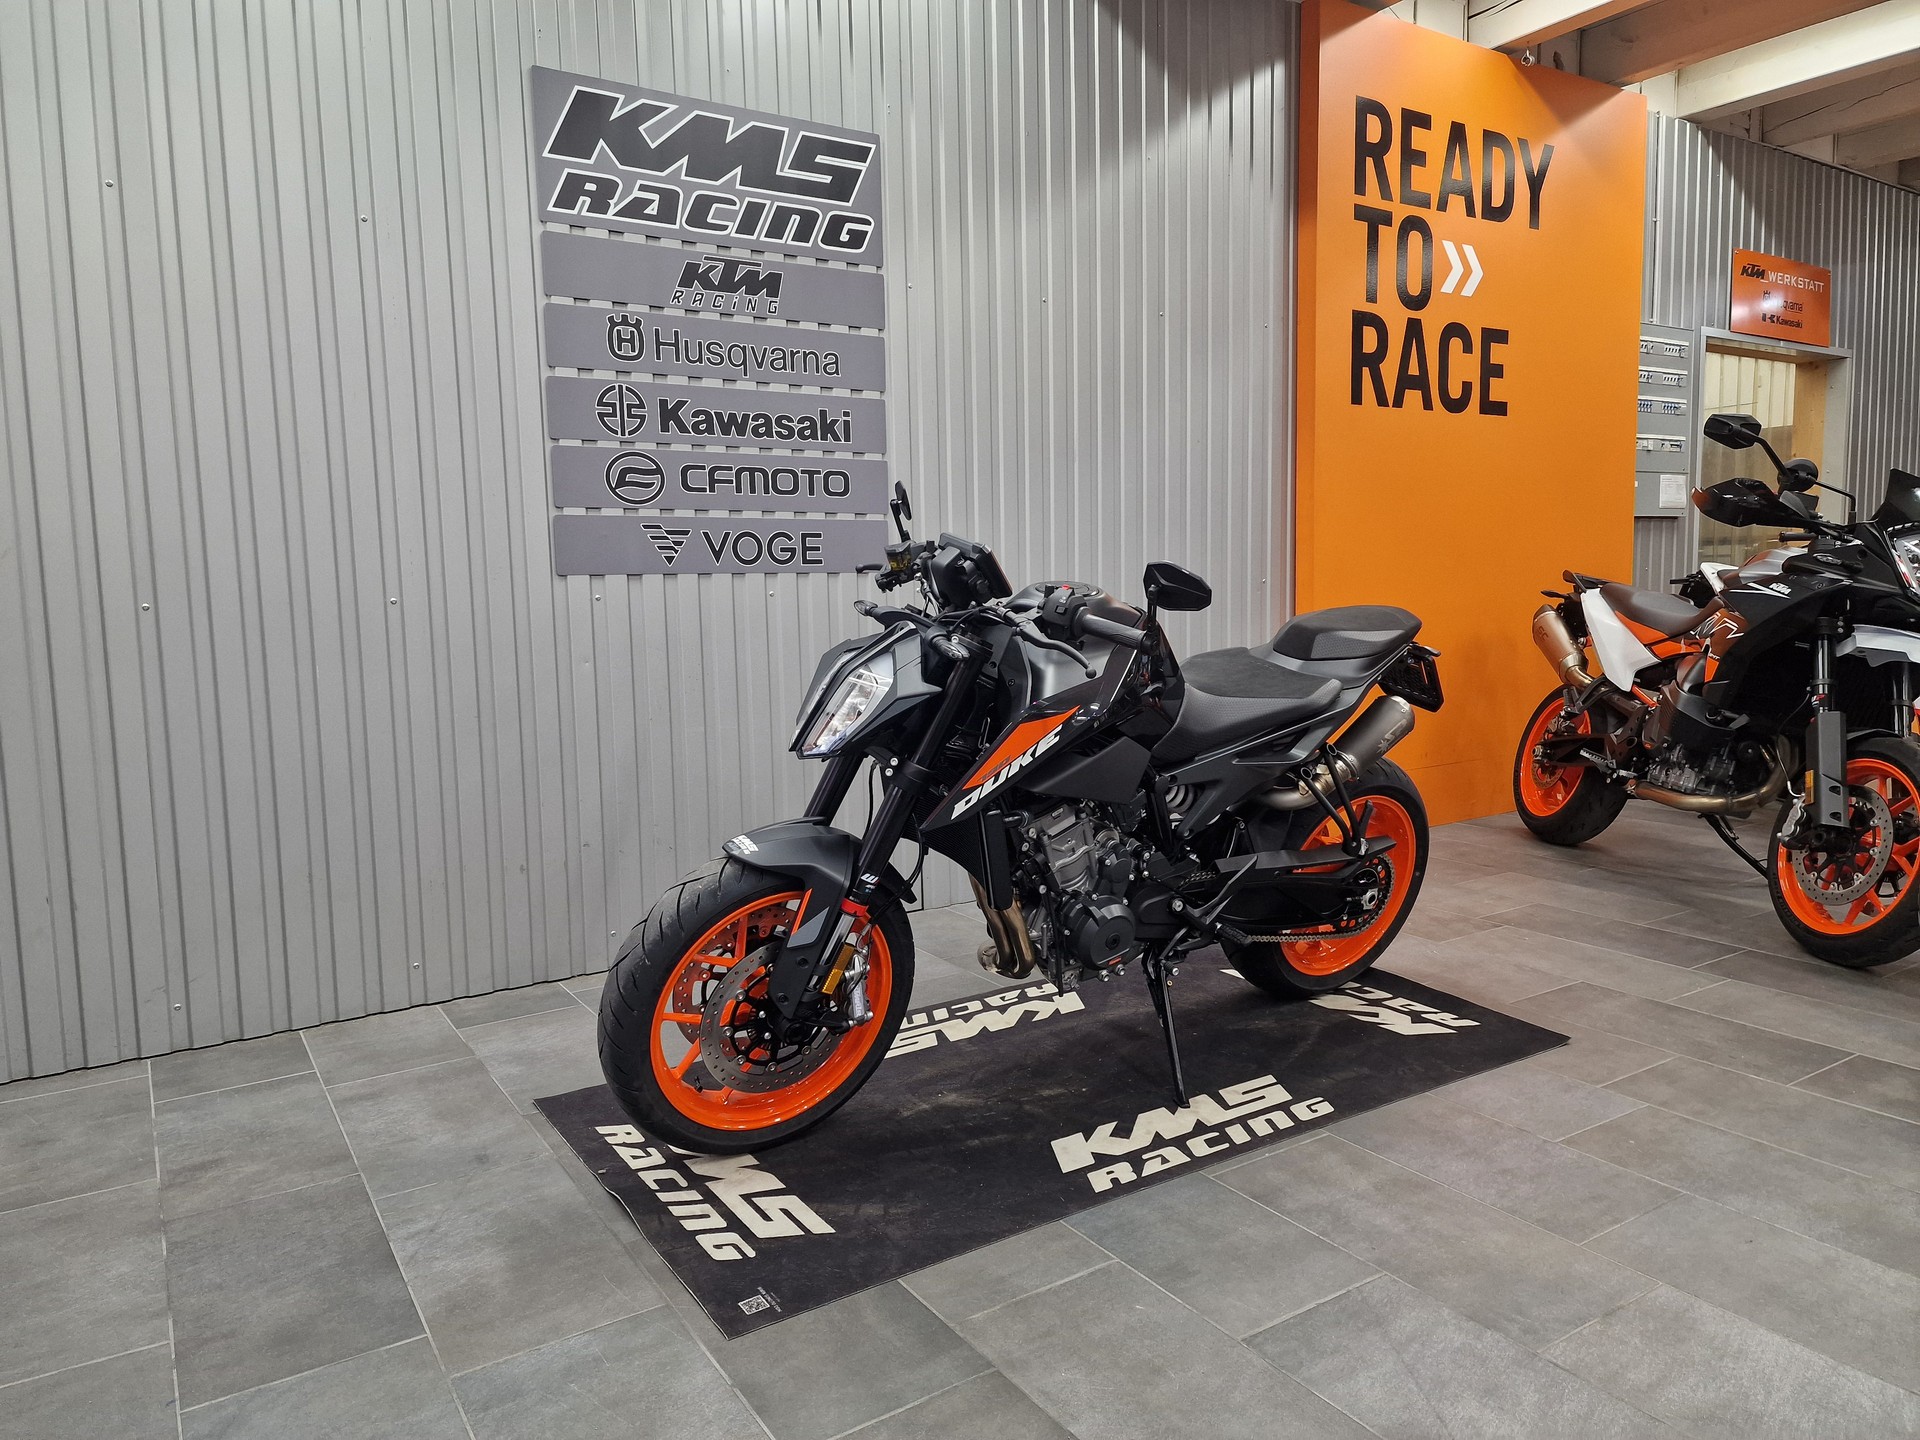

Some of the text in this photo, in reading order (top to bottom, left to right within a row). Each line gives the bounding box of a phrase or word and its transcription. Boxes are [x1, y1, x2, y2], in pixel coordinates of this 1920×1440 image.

[542, 84, 876, 206] KMS
[1354, 95, 1555, 231] READY
[546, 167, 875, 253] RACING
[676, 254, 784, 299] KTM
[1353, 203, 1434, 312] TO
[1740, 263, 1765, 279] KTM
[670, 289, 780, 315] RACING
[1776, 315, 1803, 329] Kawasaki
[653, 326, 842, 378] Husqvarna
[1350, 309, 1510, 417] RACE
[657, 397, 853, 443] Kawasaki
[679, 462, 851, 498] CFMOTO
[700, 529, 824, 567] VOGE
[1768, 582, 1792, 595] KTM
[950, 724, 1063, 820] DUKE
[899, 983, 1060, 1030] RACIN
[1050, 1074, 1293, 1174] KMS
[1087, 1096, 1335, 1193] RACING
[594, 1124, 757, 1261] RACING
[667, 1144, 837, 1239] MS
